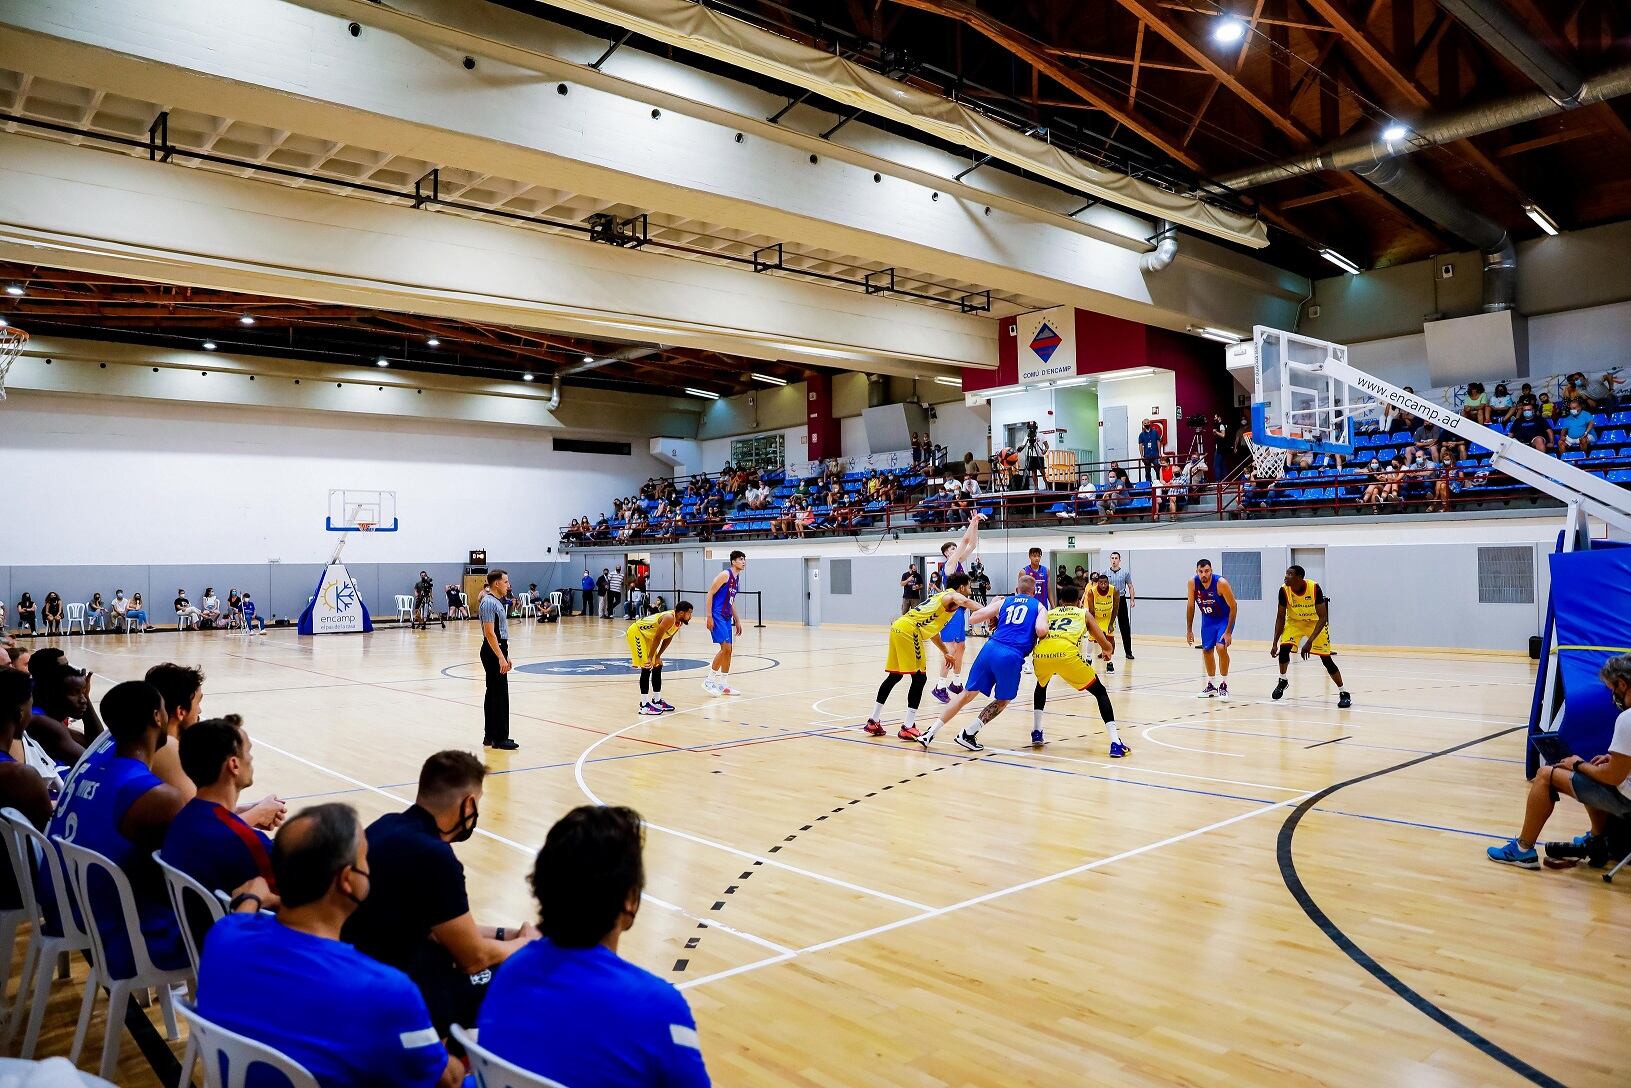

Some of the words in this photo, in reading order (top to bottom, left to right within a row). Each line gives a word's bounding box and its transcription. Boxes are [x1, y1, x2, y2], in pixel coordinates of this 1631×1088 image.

[1041, 365, 1072, 375] D'ENCAMP
[1357, 377, 1461, 429] www.encamp.ad
[320, 615, 356, 624] encamp
[1005, 605, 1028, 625] 10
